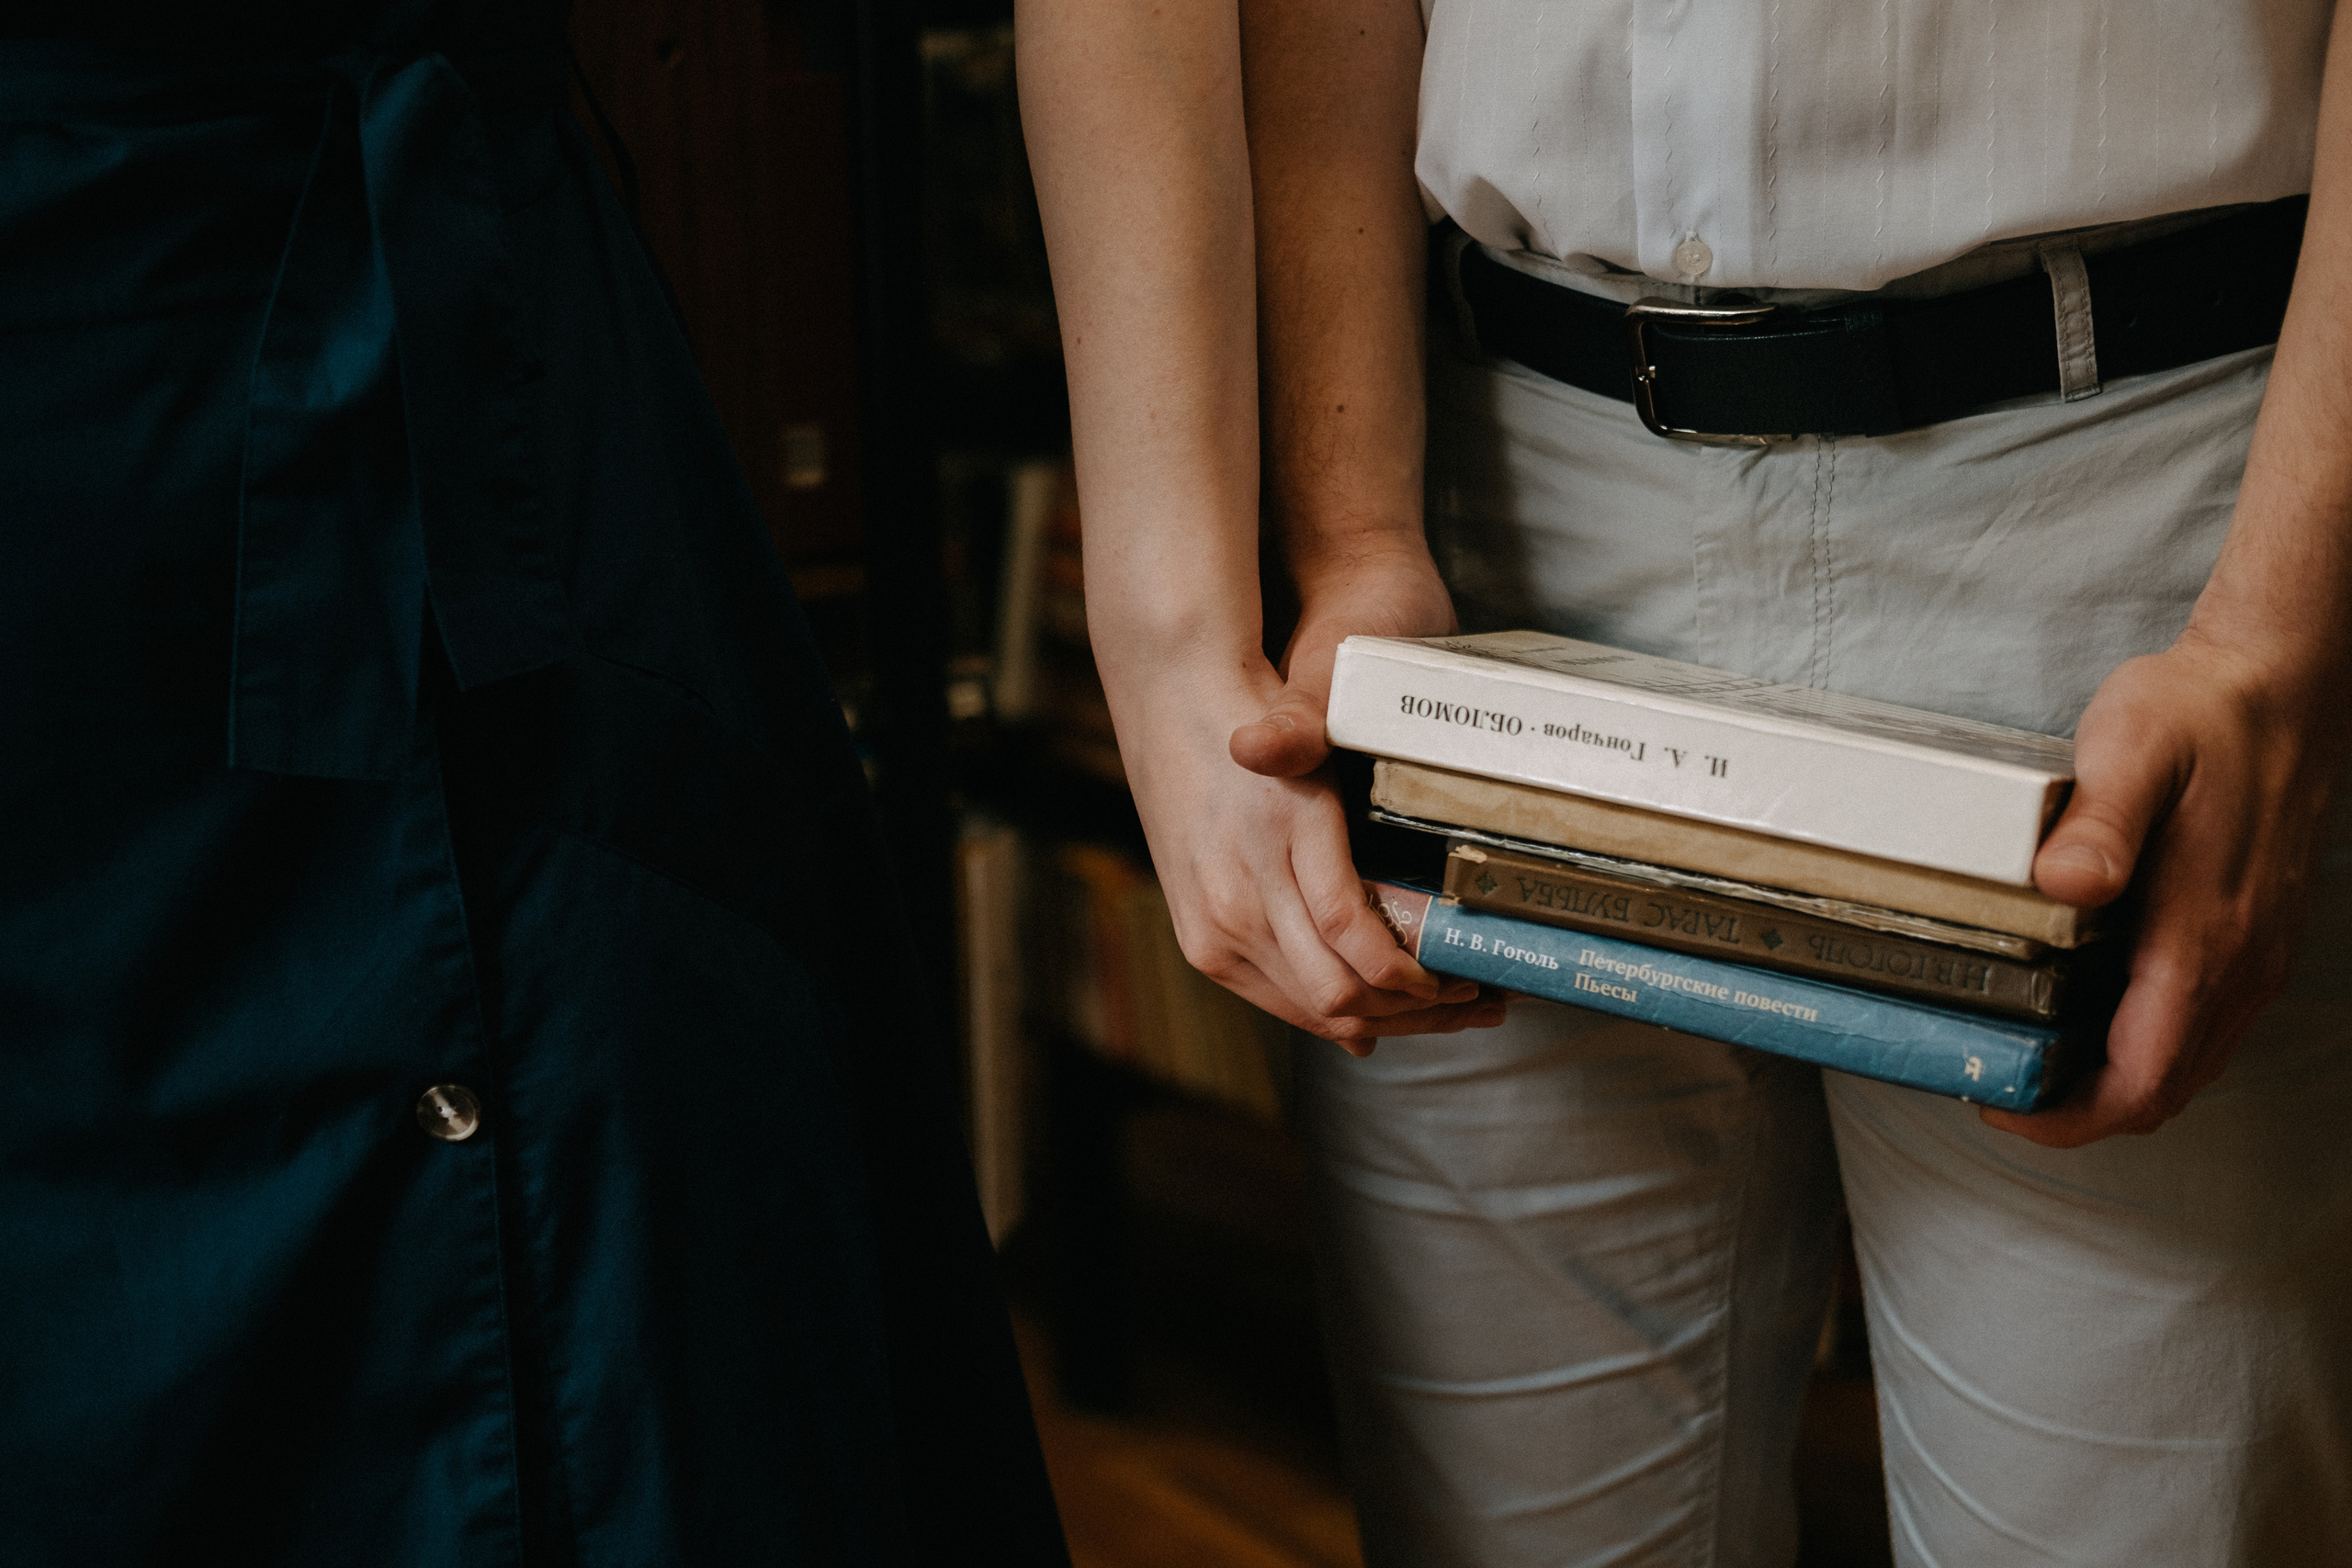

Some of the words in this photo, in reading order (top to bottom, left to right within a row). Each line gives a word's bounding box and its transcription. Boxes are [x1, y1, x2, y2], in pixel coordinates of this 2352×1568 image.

[1400, 694, 1522, 736] ОБЛОМОВ
[1544, 723, 1646, 761] Гончаров
[1664, 747, 1688, 769] А.
[1705, 755, 1728, 778] И.
[1516, 876, 1633, 922] БУЛЬБА
[1643, 902, 1741, 944] ТАРАС
[1444, 928, 1464, 947] Н.
[1469, 933, 1487, 953] В.
[1492, 939, 1559, 970] Гоголь
[1574, 972, 1638, 1004] Пьесы
[1578, 949, 1731, 1001] Петербургские
[1734, 988, 1818, 1022] повести
